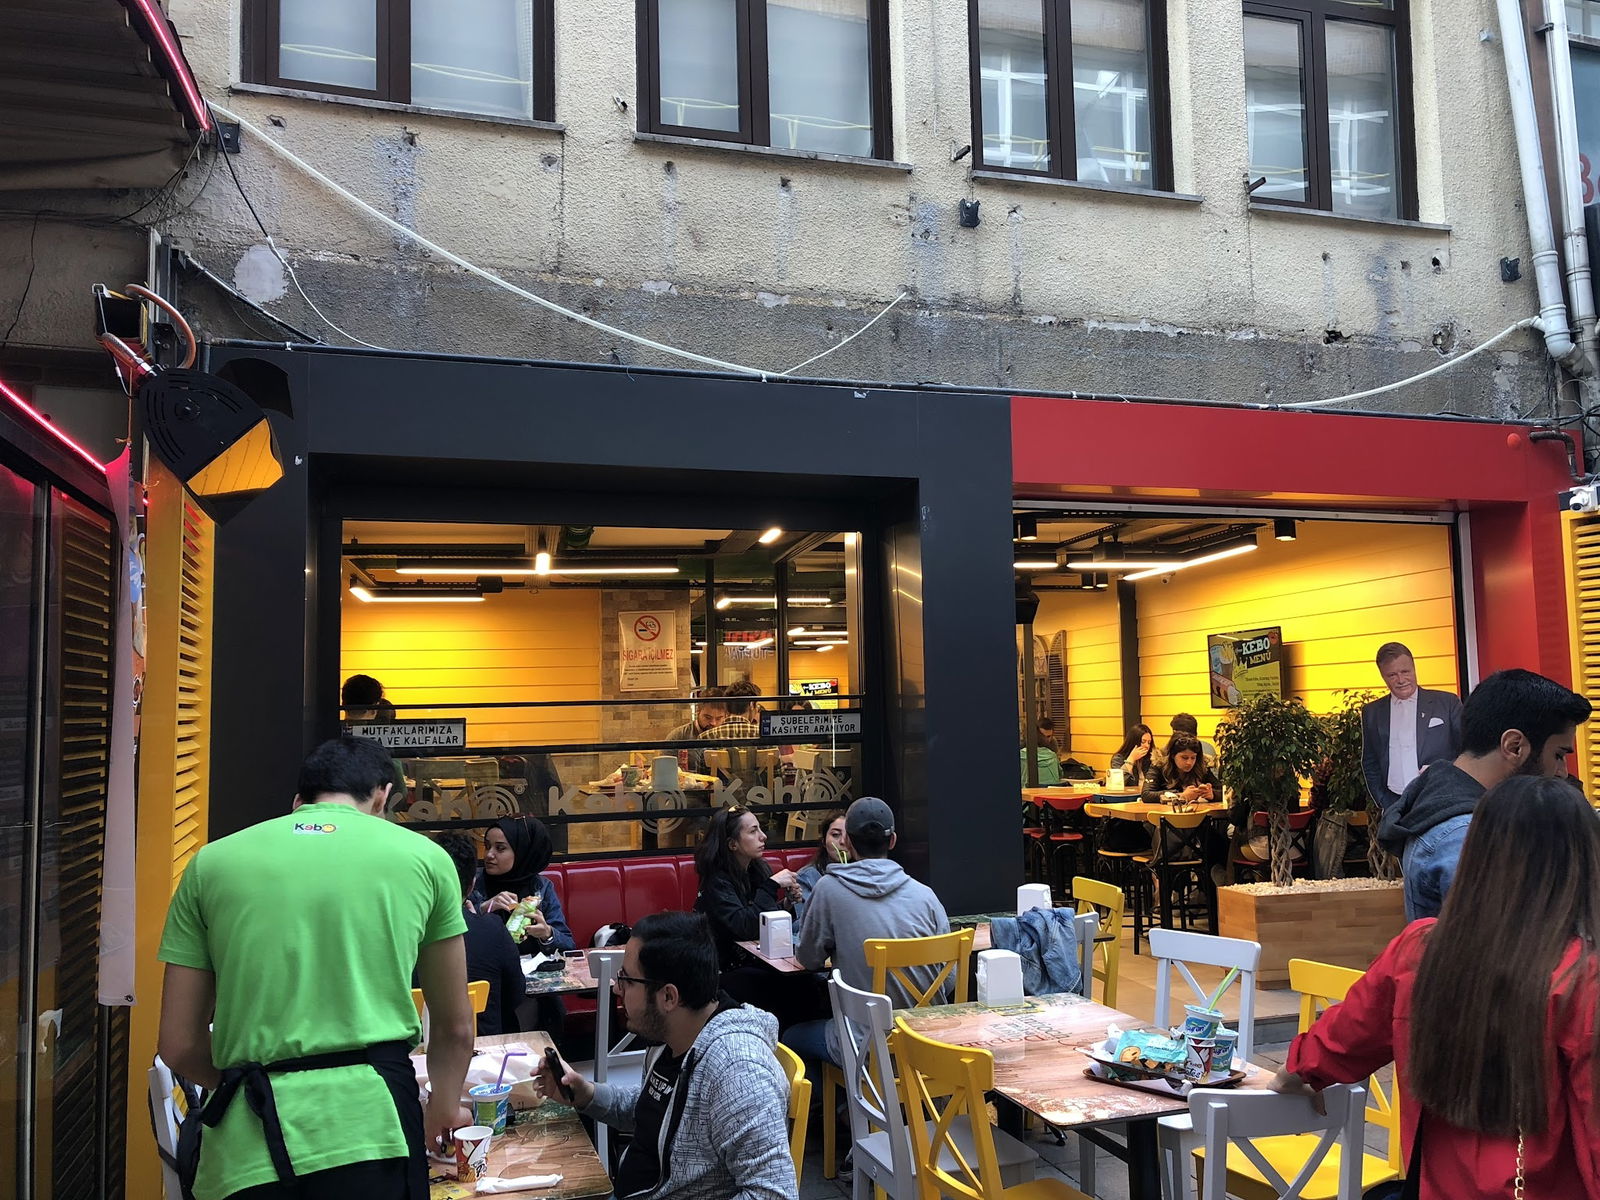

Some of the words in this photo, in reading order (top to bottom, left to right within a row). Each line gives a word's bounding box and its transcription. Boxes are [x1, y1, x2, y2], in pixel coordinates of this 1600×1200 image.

[1241, 637, 1271, 656] KEBO
[1249, 650, 1272, 665] MENÜ
[361, 726, 453, 736] MUTFAKLARIMIZA
[771, 725, 809, 735] KASİYER
[813, 723, 855, 733] ARANIYOR
[387, 736, 400, 745] VE
[404, 735, 459, 745] KALFALAR
